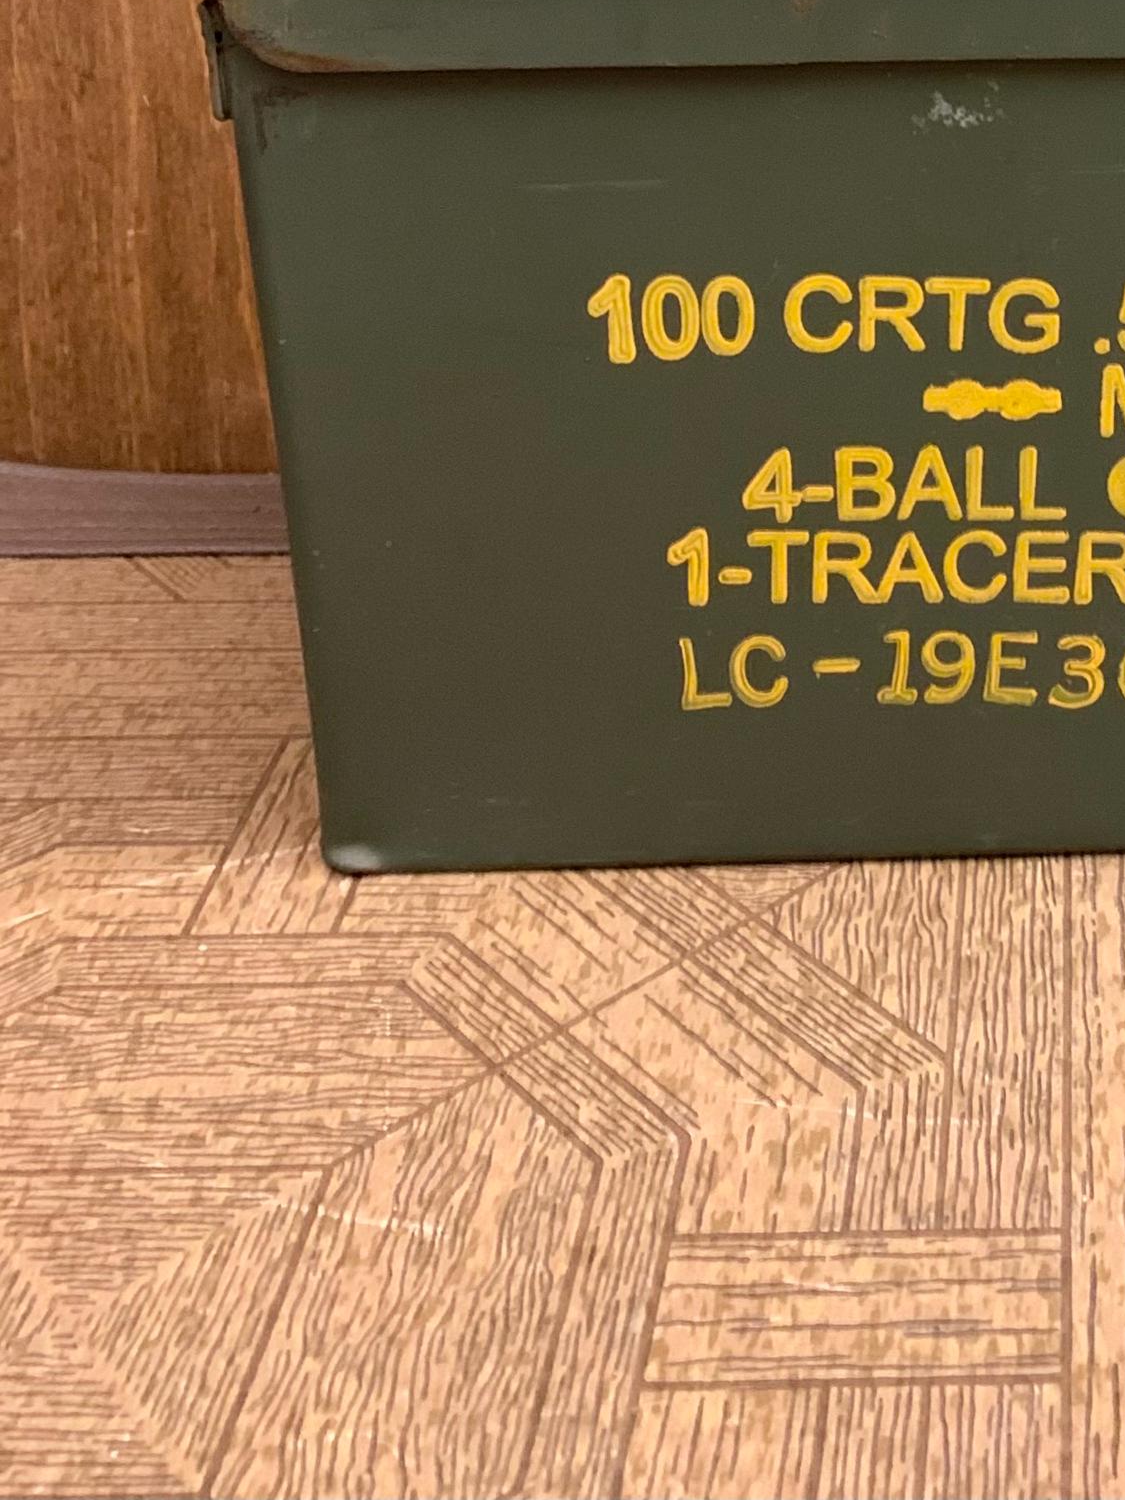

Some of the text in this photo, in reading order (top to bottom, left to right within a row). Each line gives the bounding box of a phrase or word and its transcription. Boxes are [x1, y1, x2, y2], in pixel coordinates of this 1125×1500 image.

[586, 272, 756, 365] 100
[783, 272, 1061, 355] CRTG
[741, 442, 1068, 524] 4-BALL
